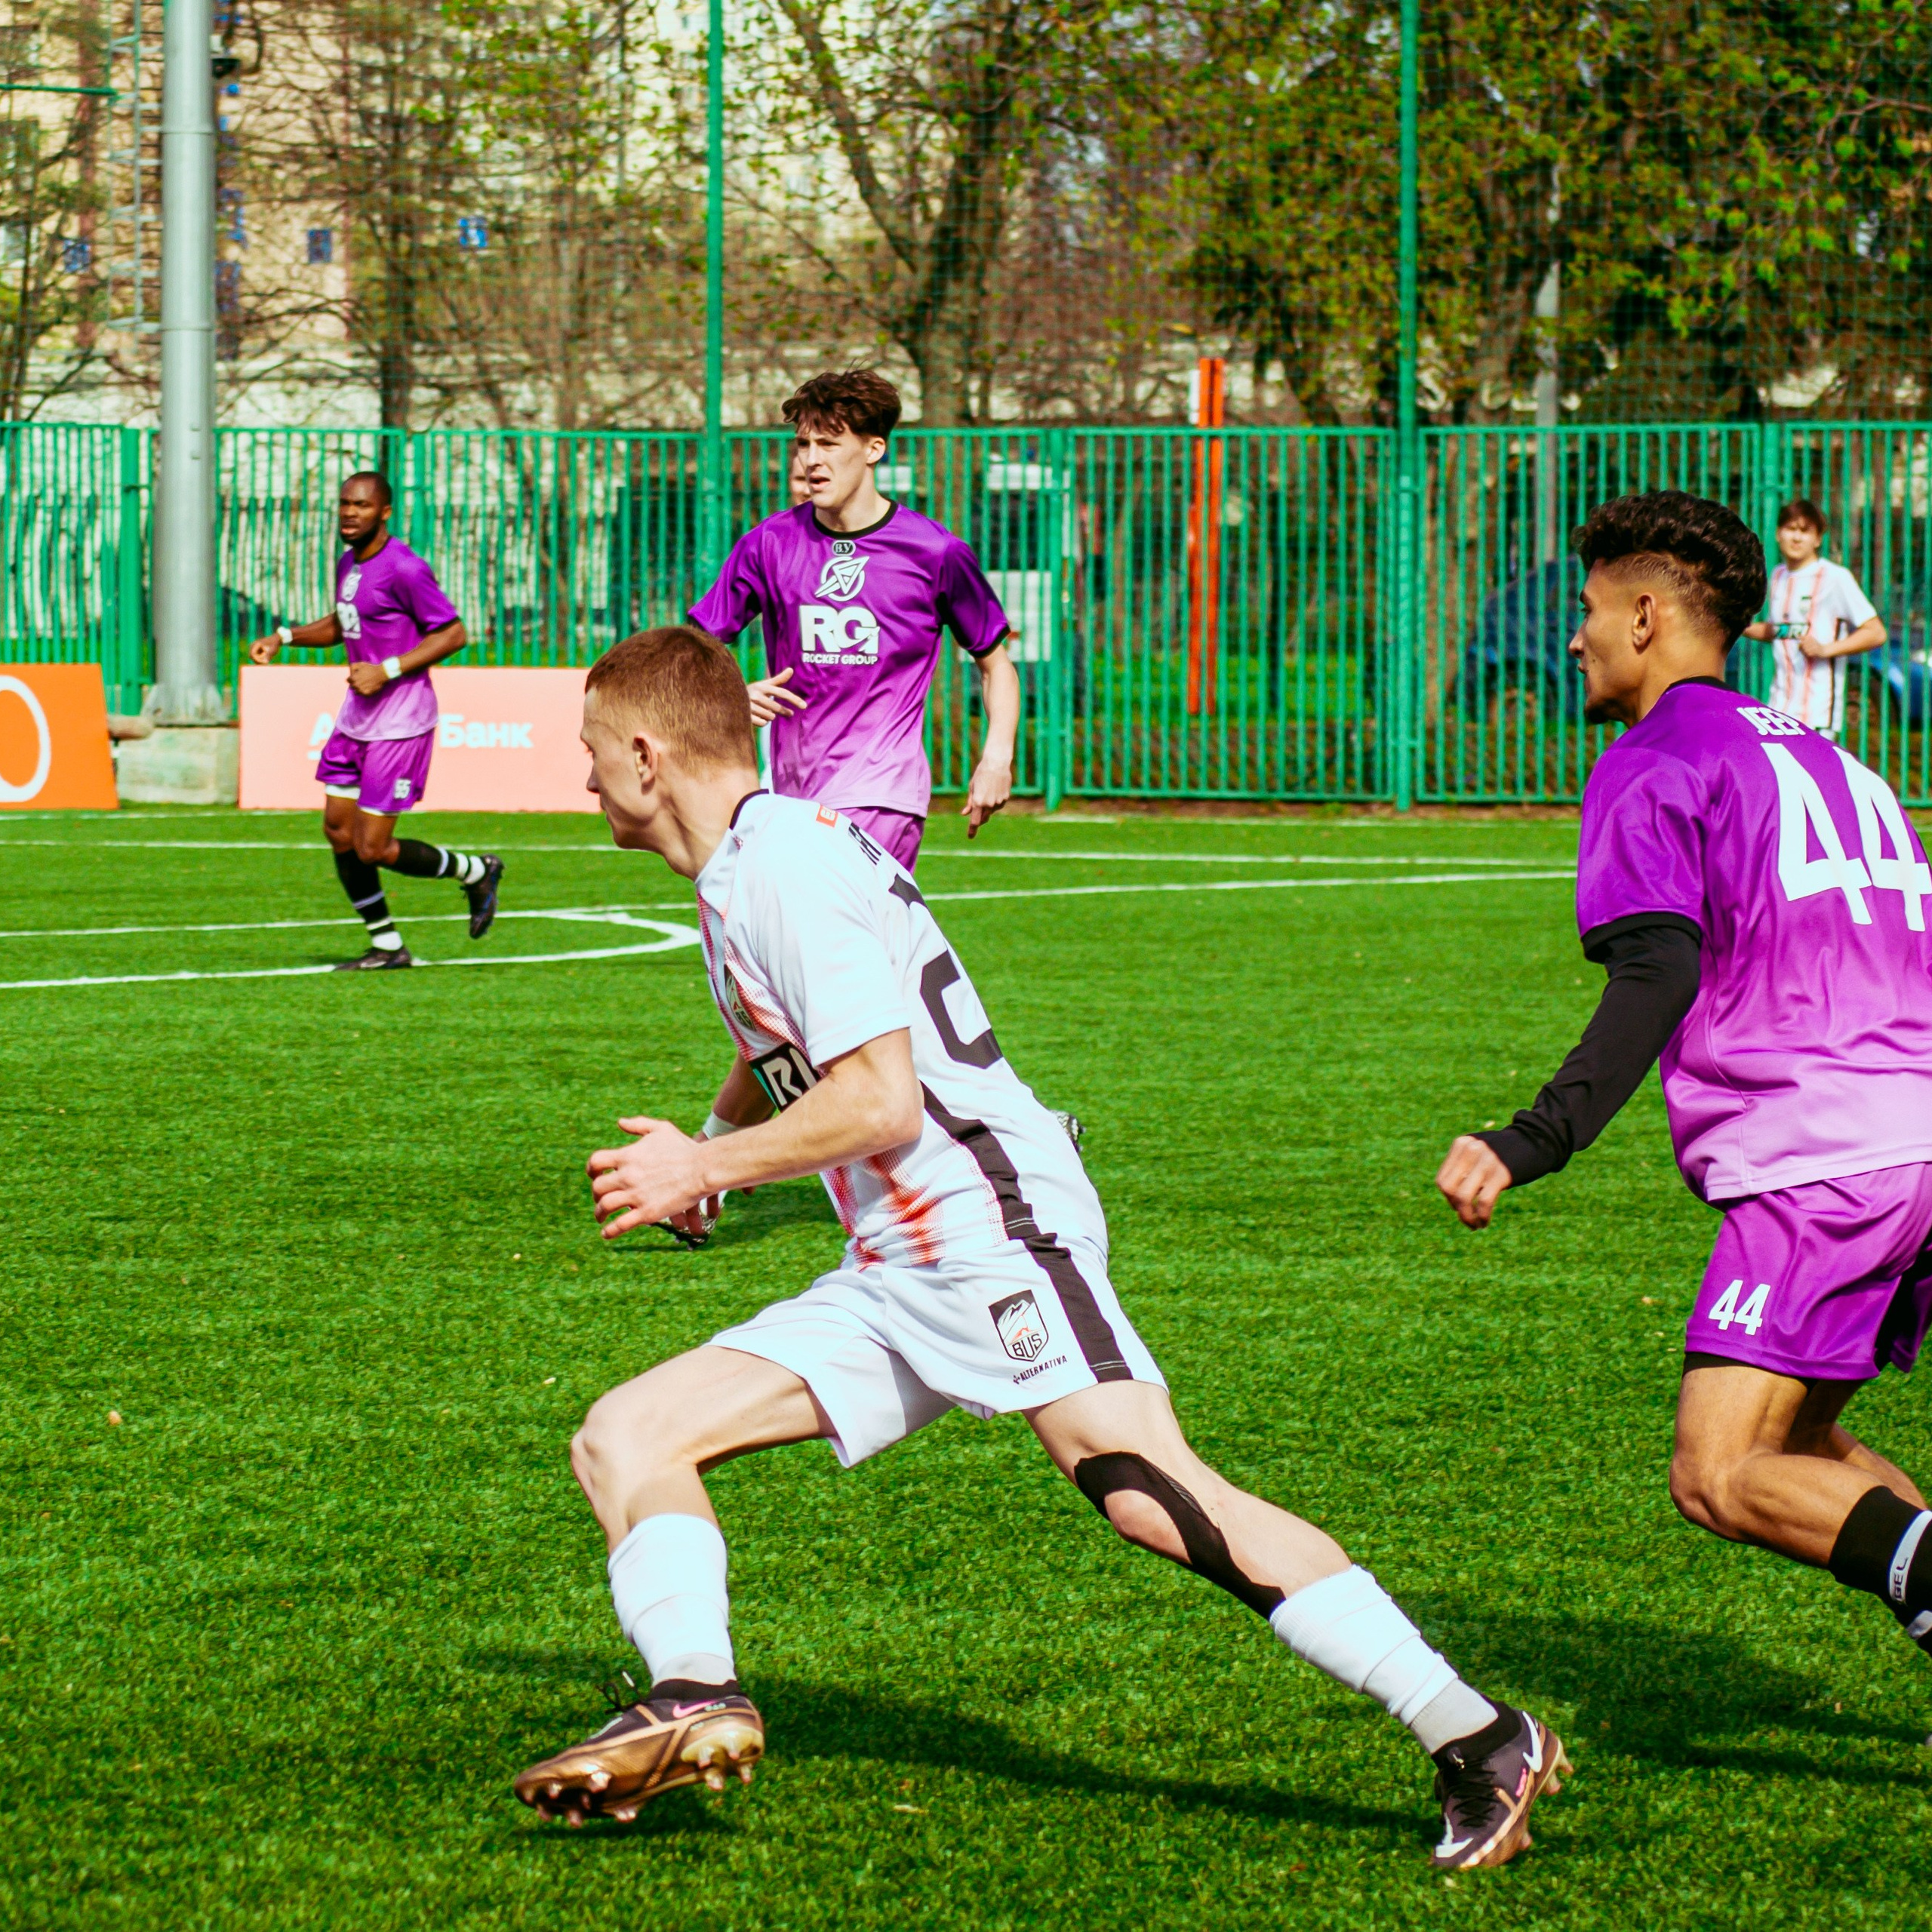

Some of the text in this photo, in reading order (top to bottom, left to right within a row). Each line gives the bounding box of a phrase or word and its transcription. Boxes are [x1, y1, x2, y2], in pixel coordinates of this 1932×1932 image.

[799, 605, 881, 654] RG
[801, 652, 878, 665] ROCKET GROUP
[438, 713, 534, 749] Банк
[1760, 742, 1932, 932] 44
[1708, 1279, 1771, 1336] 44
[1011, 1333, 1043, 1358] BUS
[1020, 1355, 1068, 1381] ALTERNATIVA
